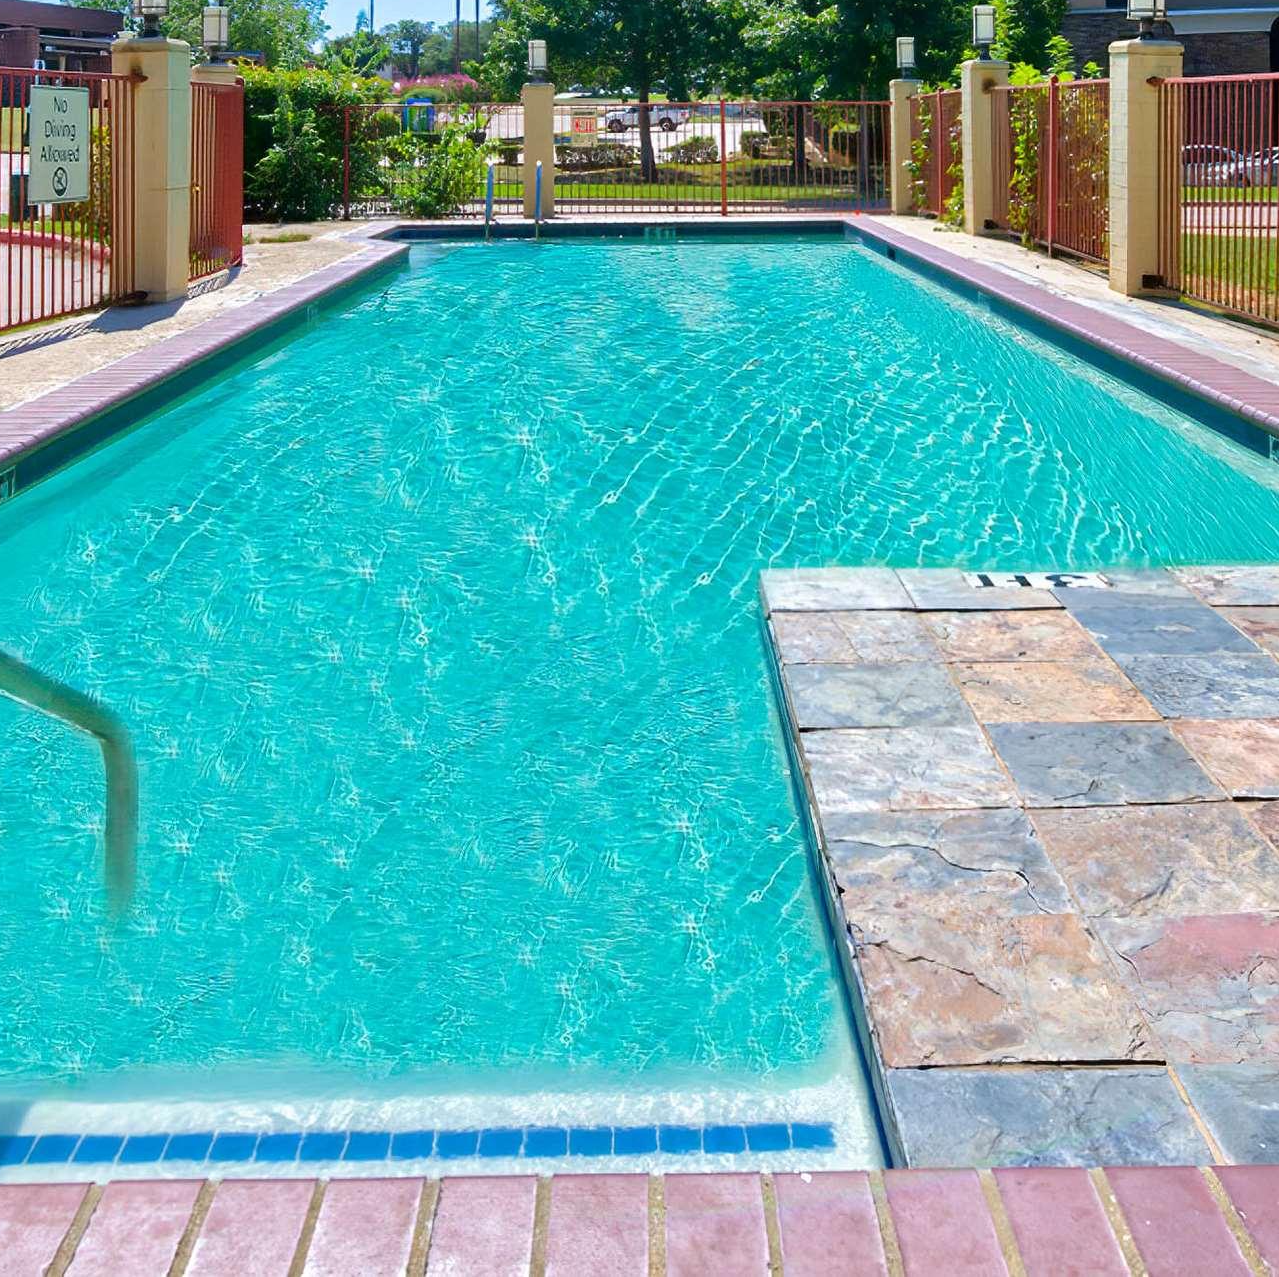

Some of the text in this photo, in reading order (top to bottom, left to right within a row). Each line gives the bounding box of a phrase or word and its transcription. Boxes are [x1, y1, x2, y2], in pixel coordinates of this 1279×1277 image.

[53, 96, 68, 113] No
[44, 120, 76, 142] Diving
[40, 145, 80, 162] Allowed
